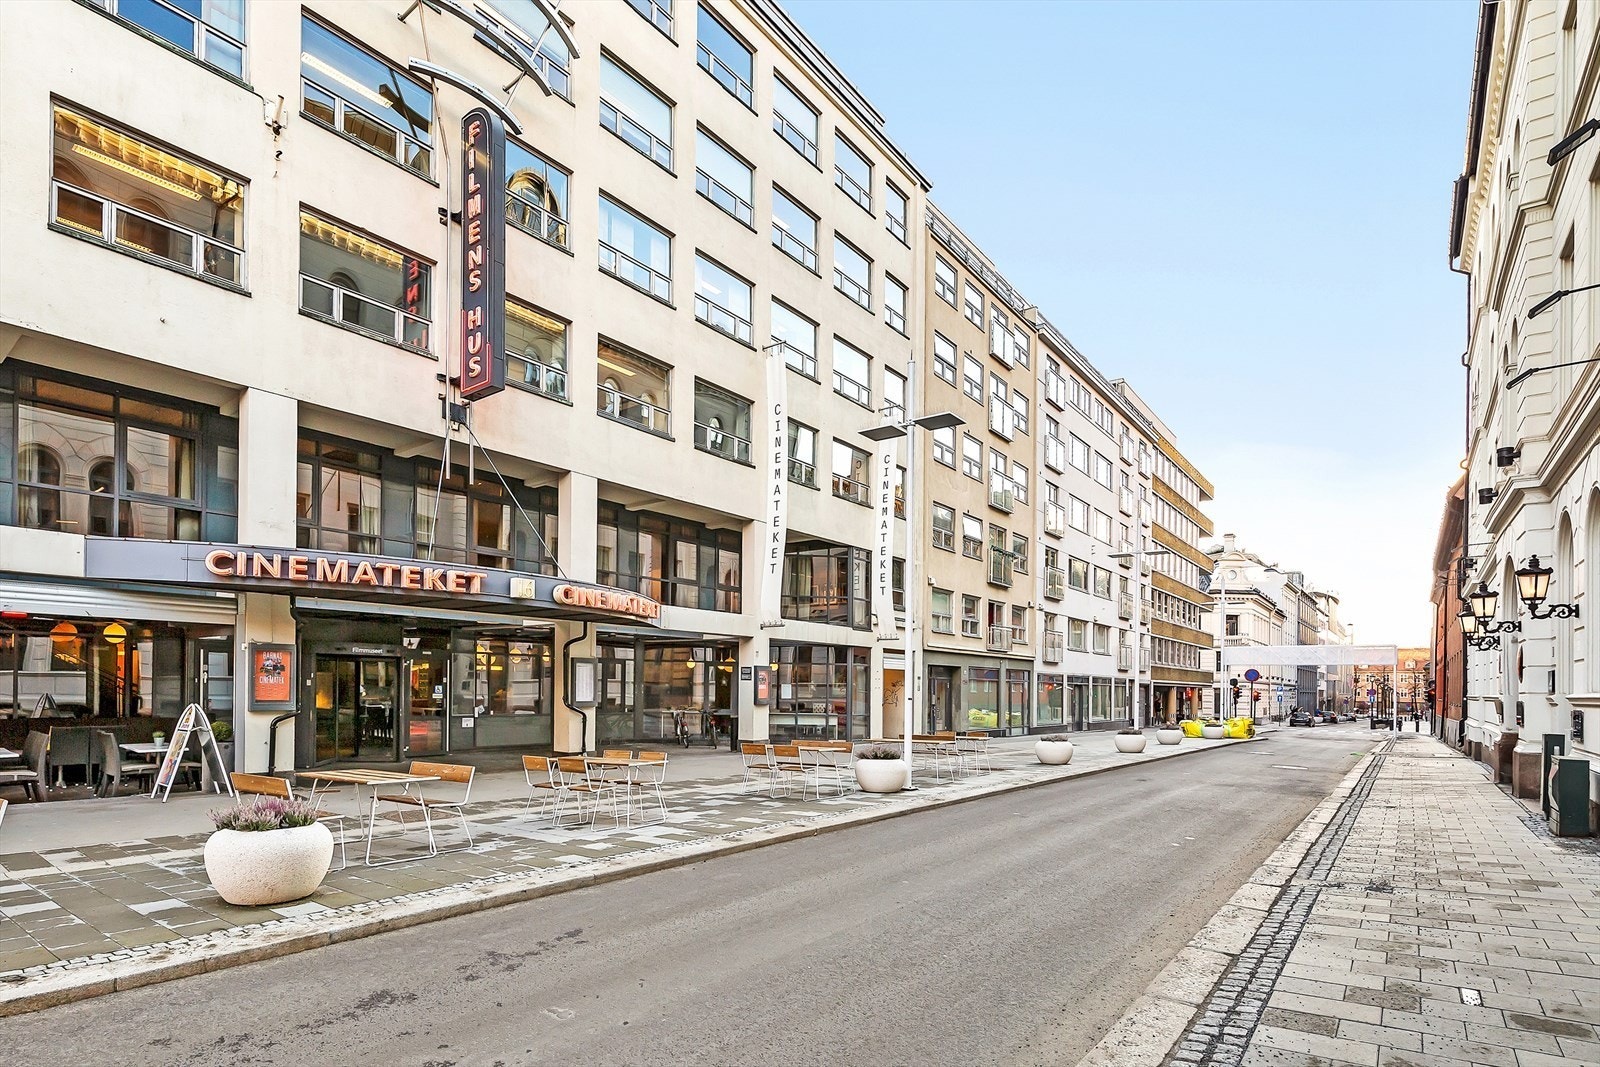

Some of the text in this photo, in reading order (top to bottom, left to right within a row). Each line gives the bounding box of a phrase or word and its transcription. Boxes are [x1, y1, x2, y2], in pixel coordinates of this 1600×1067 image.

[467, 120, 483, 378] FILMENS HUS
[770, 403, 782, 575] CINEMATEKET
[880, 454, 890, 597] CINEMATEKET
[204, 549, 488, 594] CINEMATEKET
